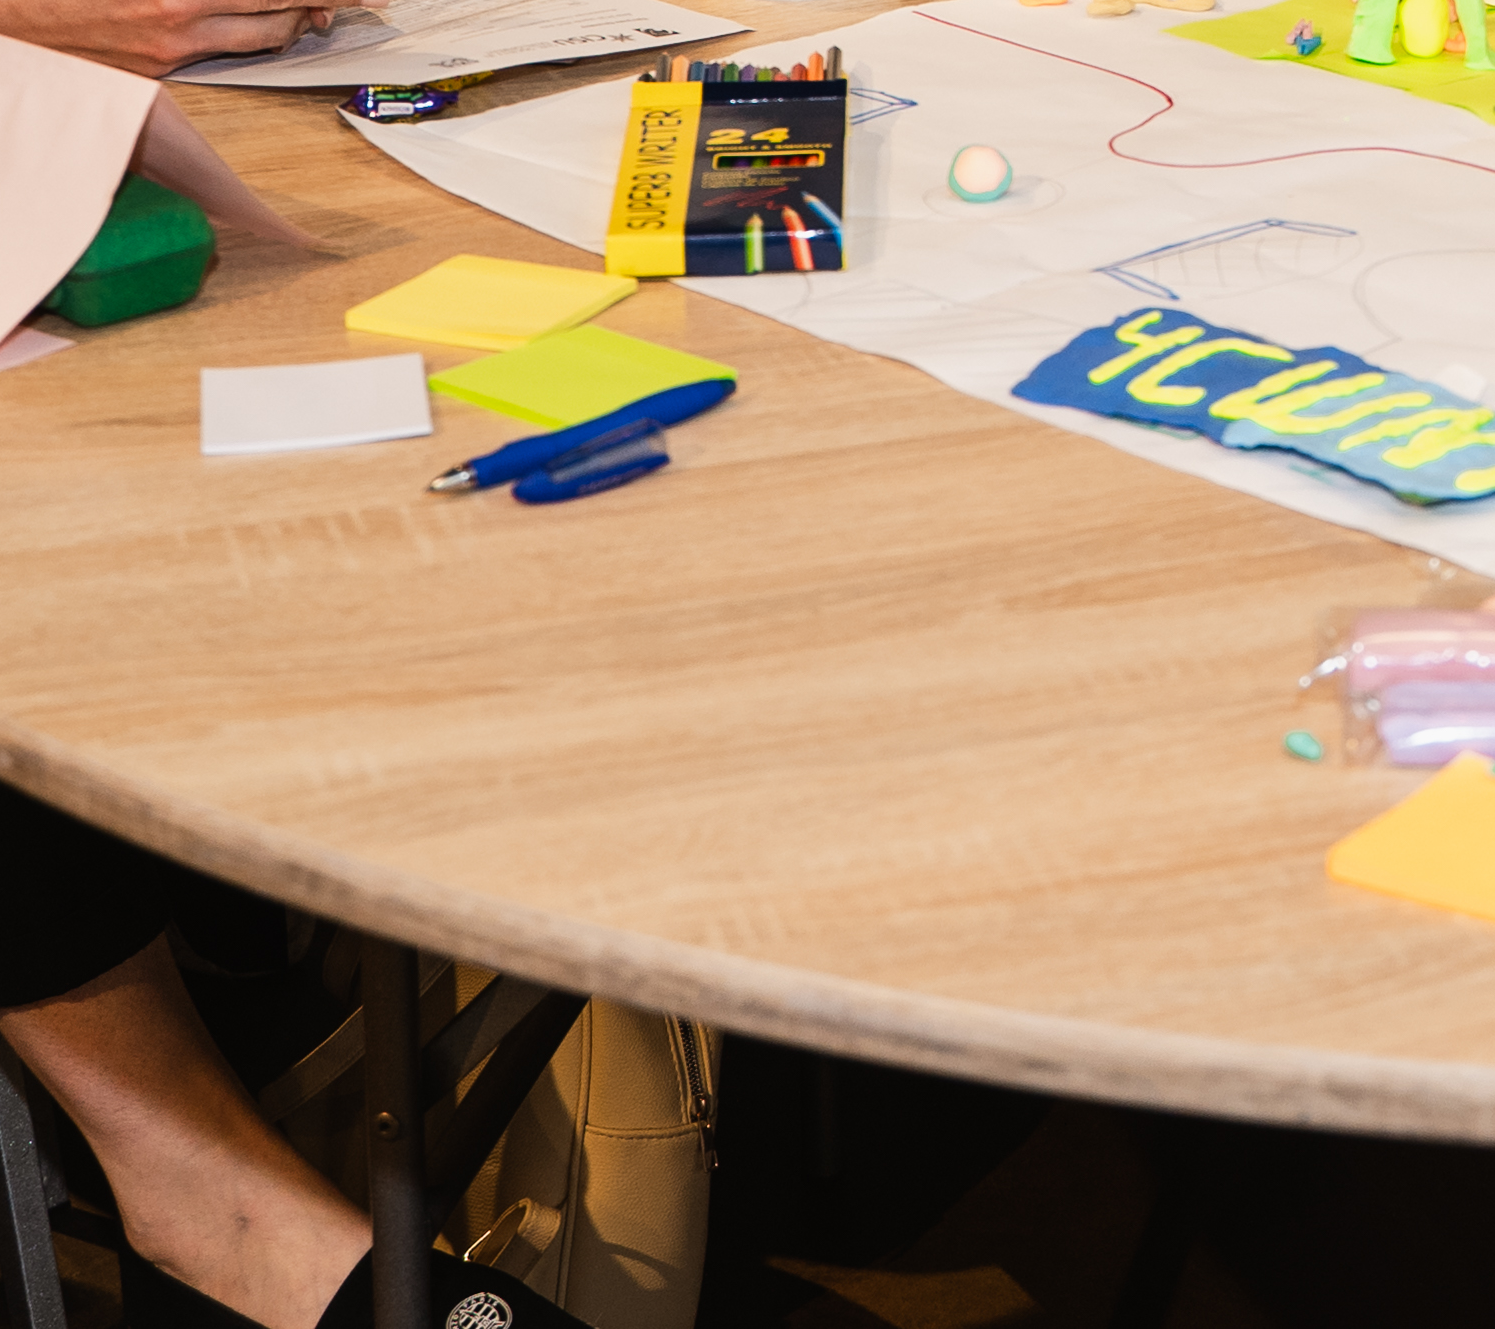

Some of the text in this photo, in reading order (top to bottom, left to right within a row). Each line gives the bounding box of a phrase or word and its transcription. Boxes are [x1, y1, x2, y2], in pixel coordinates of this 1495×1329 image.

[637, 107, 682, 169] WRITER
[706, 127, 790, 147] 24
[627, 169, 673, 230] SUPERB
